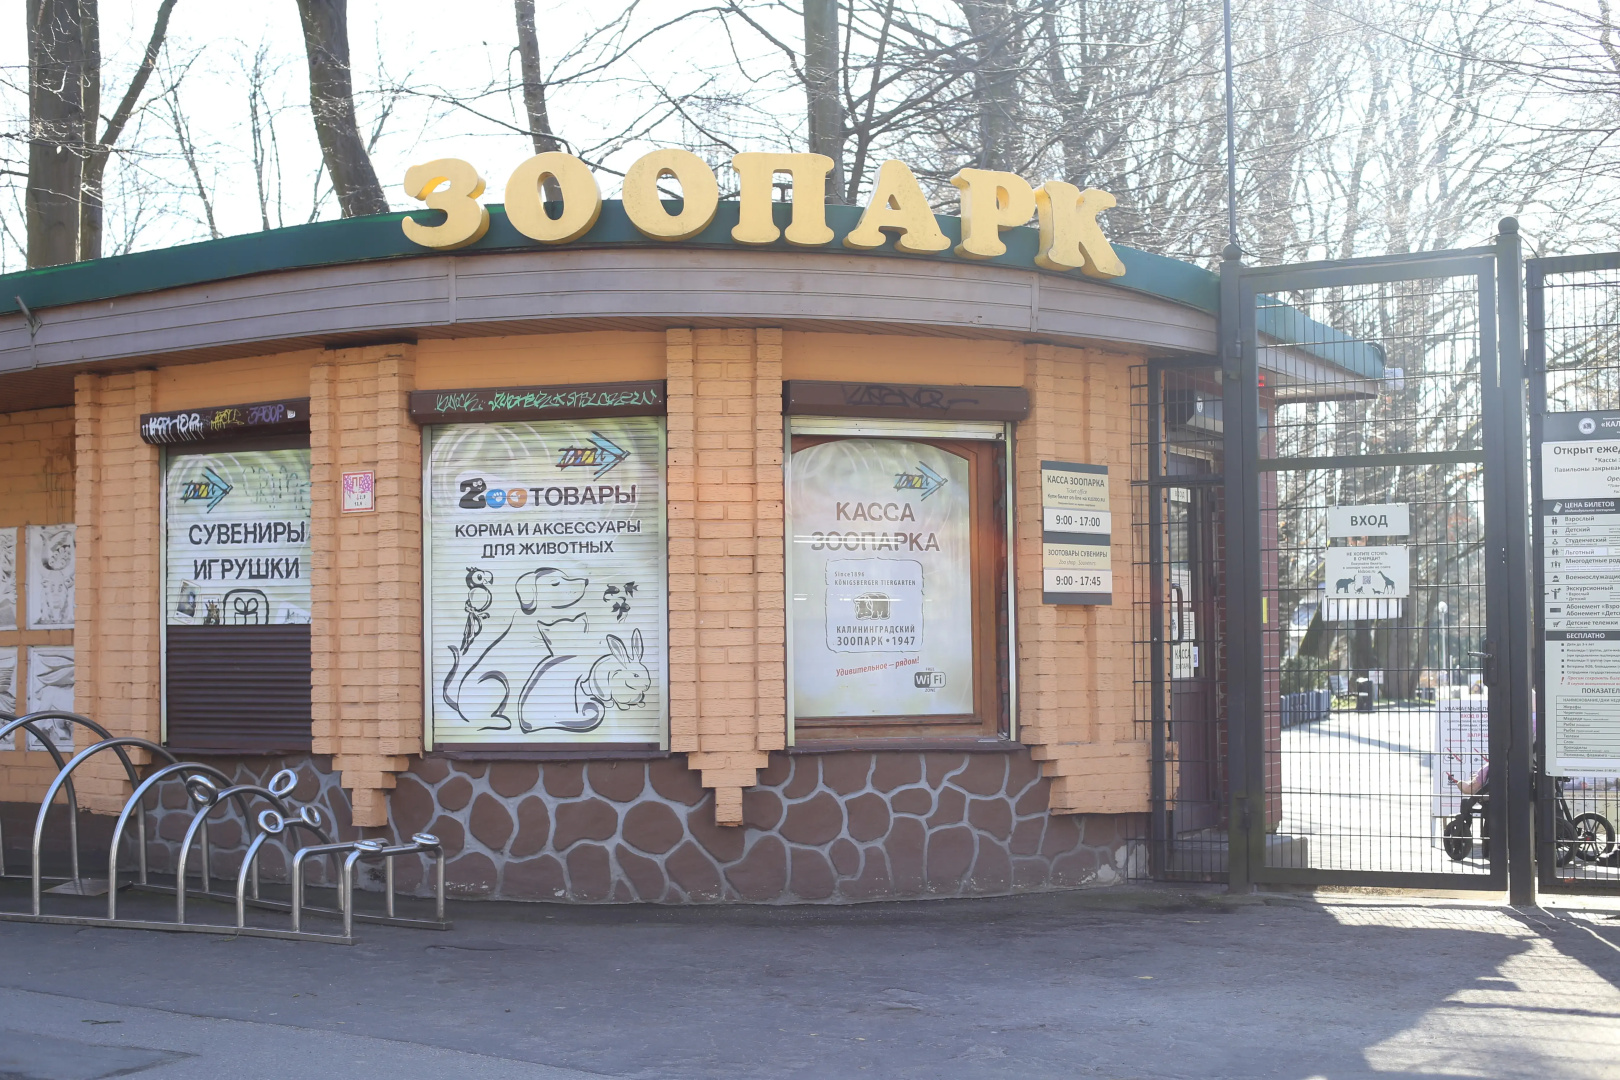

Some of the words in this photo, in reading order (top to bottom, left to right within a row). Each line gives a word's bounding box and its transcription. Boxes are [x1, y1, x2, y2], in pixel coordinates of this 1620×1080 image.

[401, 148, 1127, 278] ЗООПАРК
[1553, 446, 1594, 456] Открыт
[1597, 445, 1620, 455] еже
[1047, 475, 1069, 485] КАССА
[1069, 477, 1105, 488] ЗООПАРКА
[836, 501, 915, 522] КАССА
[455, 522, 512, 538] КОРМА
[517, 521, 529, 536] И
[532, 519, 641, 536] АКСЕССУАРЫ
[1055, 515, 1073, 526] 9:00
[1079, 516, 1100, 527] 17:00
[1350, 514, 1388, 528] ВХОД
[188, 521, 305, 545] СУВЕНИРЫ
[481, 543, 515, 559] ДЛЯ
[517, 540, 615, 556] ЖИВОТНЫХ
[811, 531, 941, 552] ЗООПАРКА
[1048, 549, 1080, 557] ЗООТОВАРЫ
[1080, 550, 1107, 558] СУВЕНИРЫ
[193, 557, 300, 580] ИГРУШКИ
[1055, 575, 1073, 586] 9:00
[1080, 576, 1101, 586] 17:45
[836, 624, 915, 635] КАЛИНИНГРАДСКИЙ
[837, 636, 883, 646] ЗООПАРК
[892, 636, 916, 646] 1947
[836, 662, 888, 677] Удивительное
[895, 656, 920, 669] рядом!
